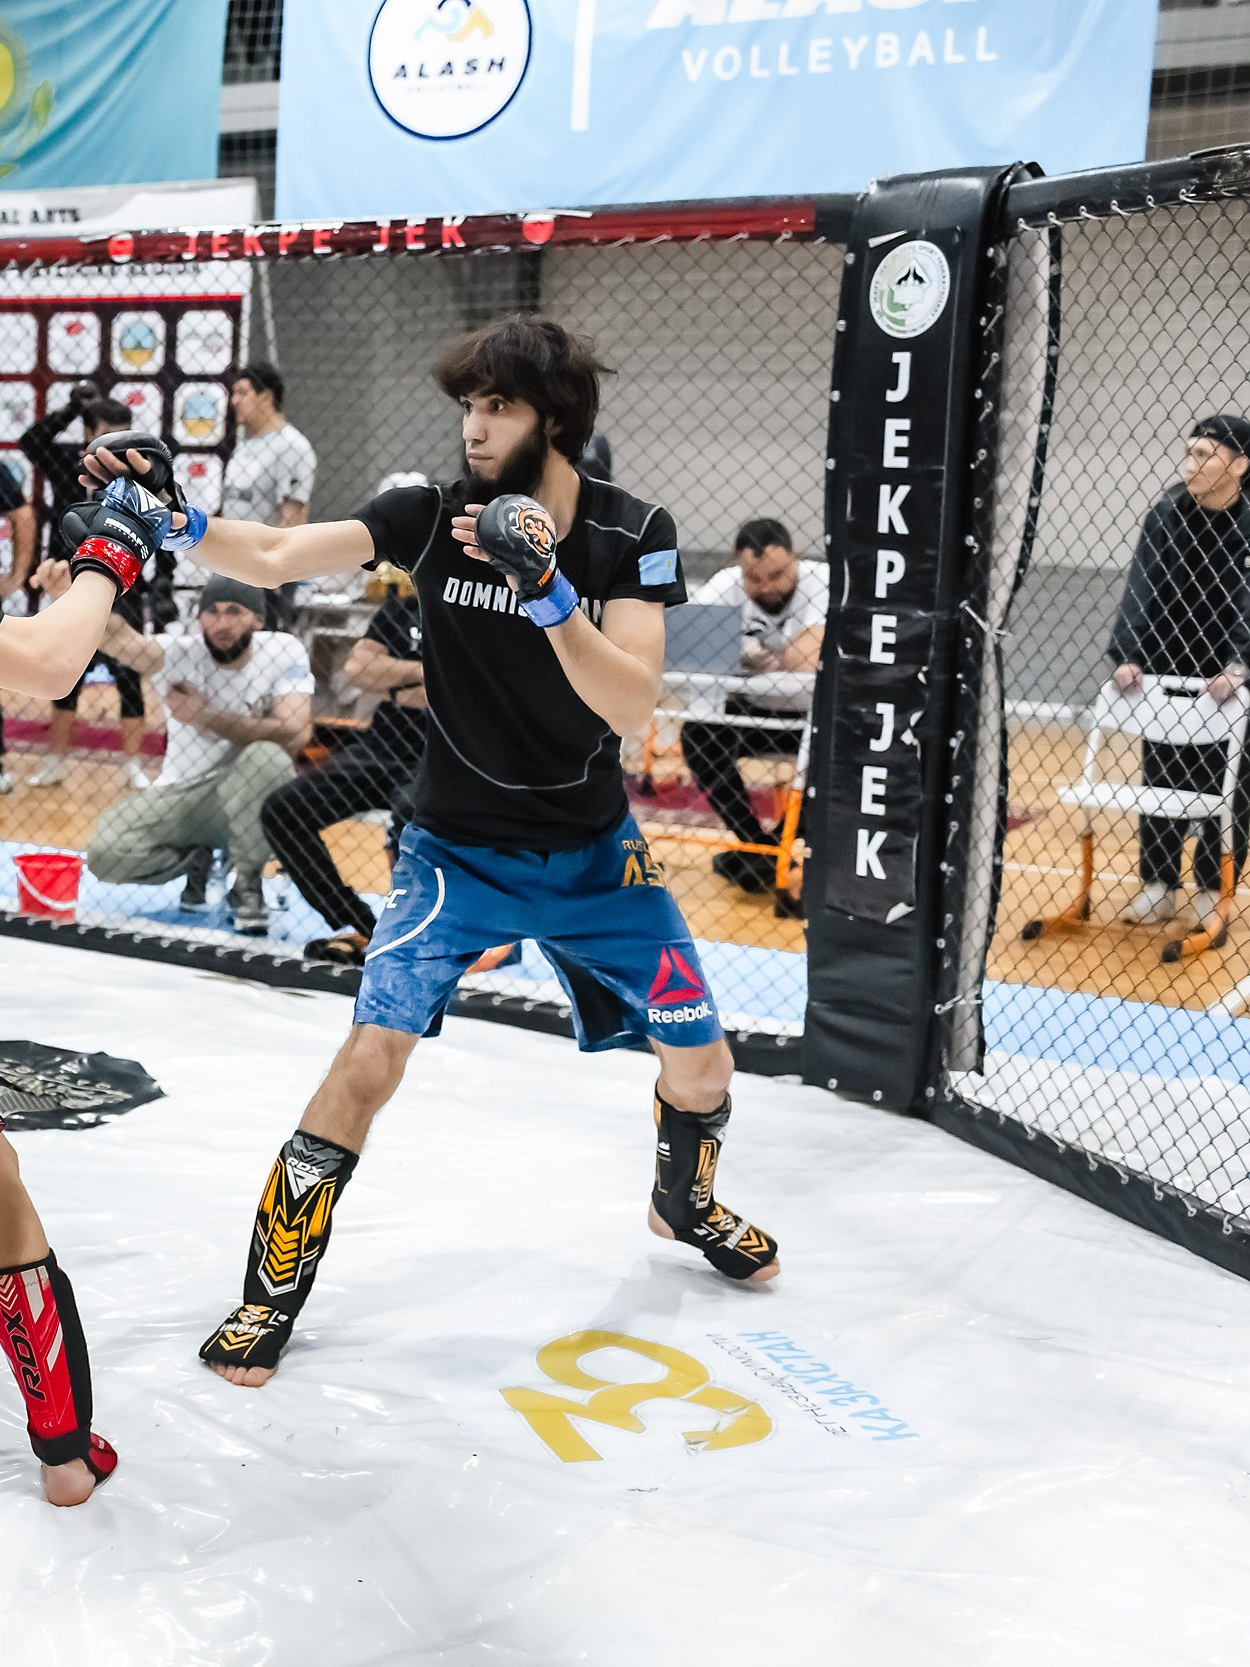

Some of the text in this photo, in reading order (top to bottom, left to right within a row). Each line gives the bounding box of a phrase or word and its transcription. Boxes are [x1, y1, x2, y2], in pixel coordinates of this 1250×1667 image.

[393, 57, 505, 79] ALASH
[682, 26, 998, 83] VOLLEYBALL
[180, 215, 467, 260] JEKPE JEK
[869, 352, 912, 665] JEKPE
[855, 702, 895, 880] JEK
[648, 1001, 713, 1025] Reebok
[286, 1157, 324, 1176] RDX
[0, 1307, 47, 1402] RDX
[737, 1331, 921, 1441] КАЗАХСТАН
